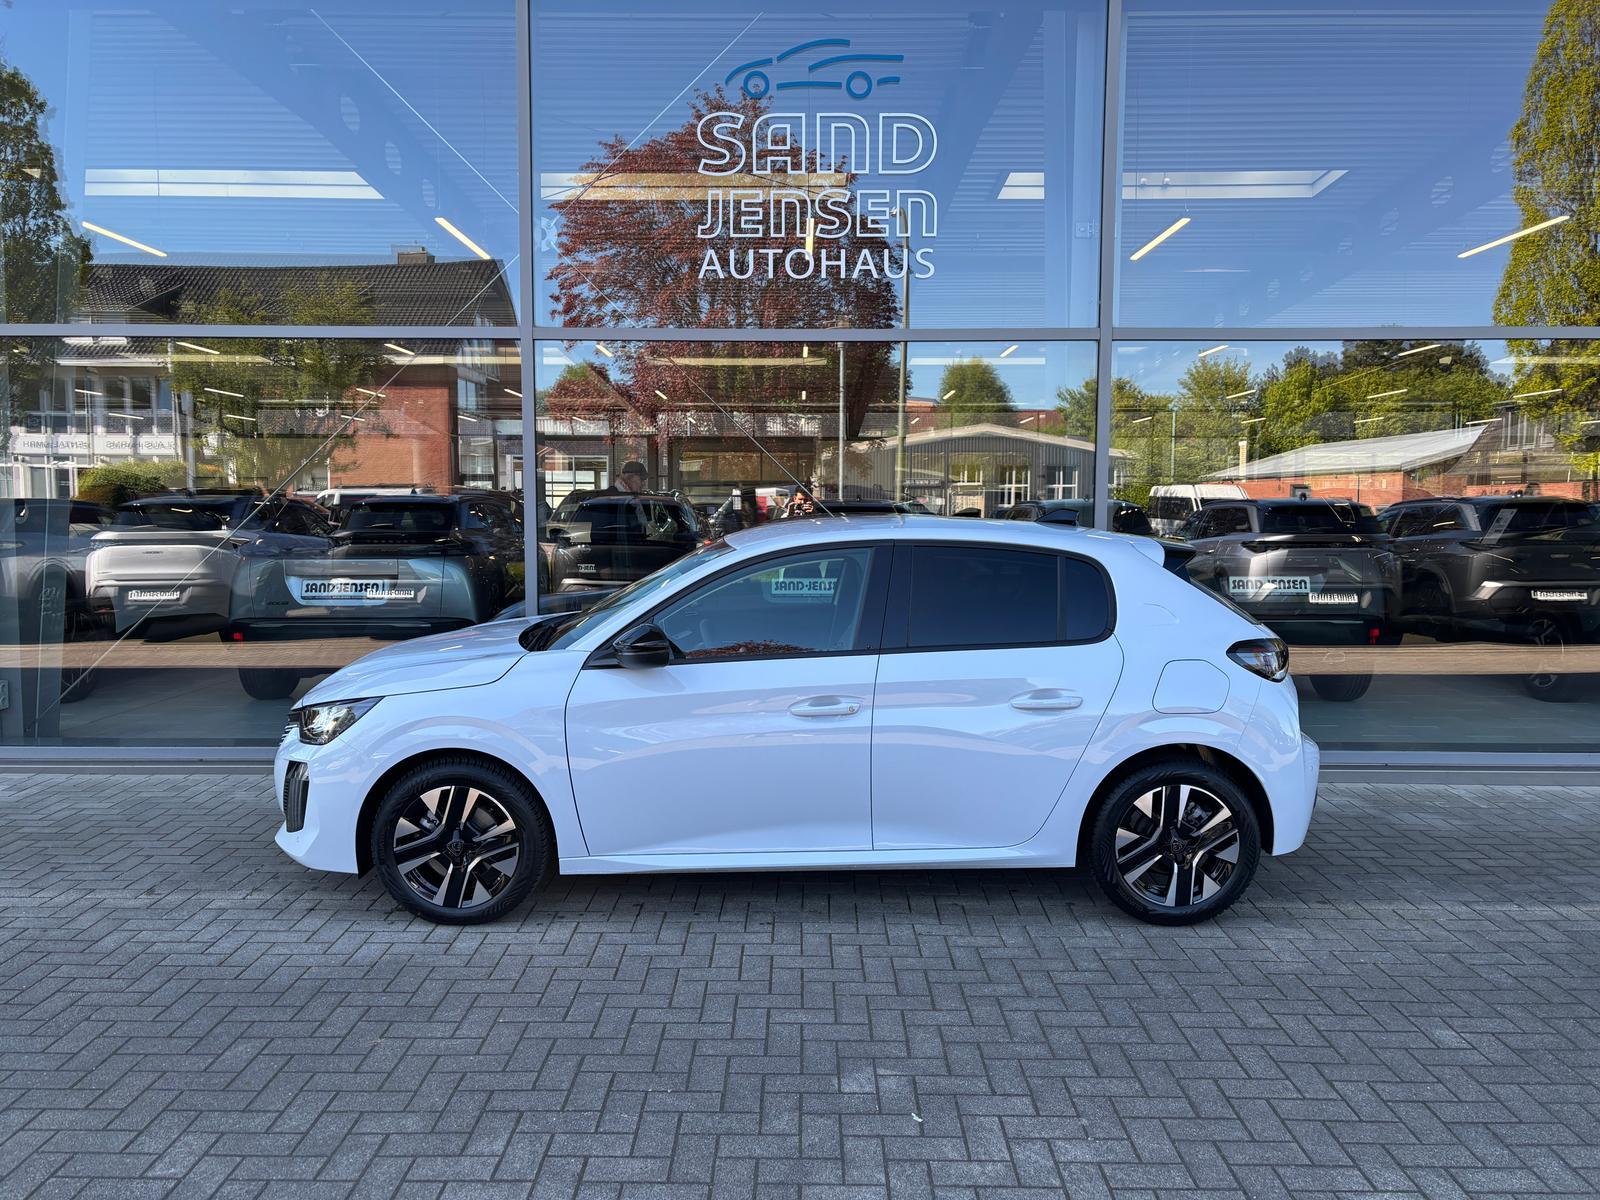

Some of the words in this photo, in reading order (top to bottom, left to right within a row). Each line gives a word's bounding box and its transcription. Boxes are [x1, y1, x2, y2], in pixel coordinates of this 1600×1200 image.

[697, 112, 938, 176] SAND
[697, 189, 938, 239] JENSEN
[698, 248, 936, 279] AUTOHAUS
